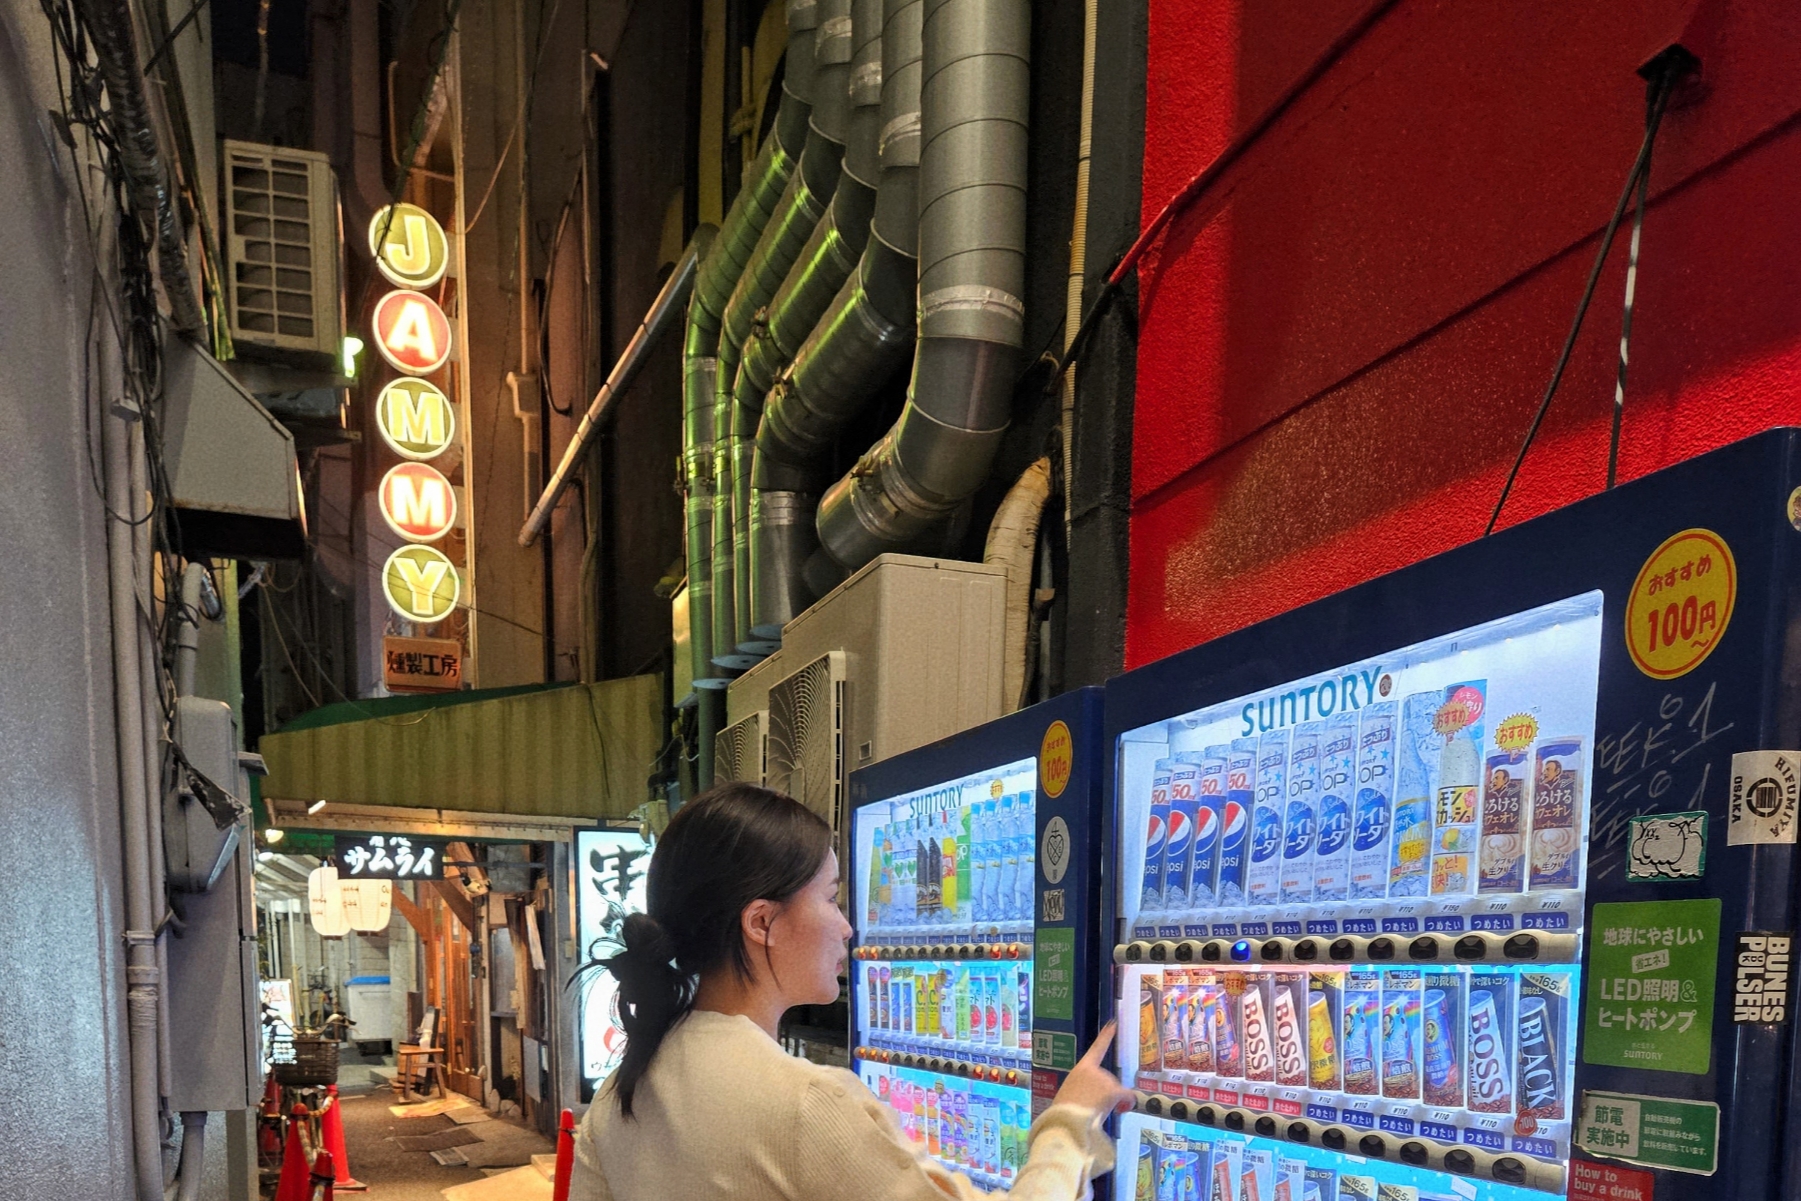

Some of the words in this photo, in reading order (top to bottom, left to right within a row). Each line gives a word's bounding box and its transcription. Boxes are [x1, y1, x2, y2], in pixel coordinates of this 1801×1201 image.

[384, 214, 446, 614] JAMMY
[1649, 554, 1711, 597] おすすめ
[1241, 665, 1382, 737] SUNTORY
[1436, 708, 1466, 728] おすすめ
[1500, 723, 1532, 743] おすすめ
[910, 784, 964, 819] SUNTORY
[1732, 775, 1743, 824] OSAKA
[344, 846, 435, 877] サムライ
[1489, 903, 1508, 911] ¥110
[1542, 901, 1561, 909] ¥110
[1274, 925, 1299, 934] つめたい
[1309, 923, 1335, 933] つめたい
[1345, 922, 1375, 932] つめたい
[1385, 922, 1415, 931] つめたい
[1427, 920, 1461, 931] つめたい
[1474, 919, 1511, 929] つめたい
[1525, 917, 1564, 928] つめたい
[1603, 926, 1704, 946] 地球にやさしい
[1635, 953, 1667, 970] 省エネ!
[1761, 936, 1791, 1022] BUNES
[1038, 985, 1069, 999] ヒートポンプ
[1598, 1006, 1698, 1034] ヒートポンプ
[1245, 999, 1268, 1070] BOSS
[1276, 1000, 1300, 1074] BOSS
[1470, 1007, 1504, 1099] BOSS
[1623, 1049, 1663, 1061] SUNTORY
[1519, 1017, 1556, 1109] BLACK
[1275, 1101, 1300, 1113] あたたかい
[1309, 1108, 1335, 1118] つめたい
[1393, 1107, 1408, 1115] ¥110
[1344, 1113, 1372, 1125] つめたい
[1434, 1112, 1450, 1120] ¥110
[1594, 1104, 1624, 1127] 節電
[1382, 1119, 1412, 1131] つめたい
[1480, 1119, 1497, 1127] ¥110
[1423, 1126, 1455, 1138] つめたい
[1467, 1132, 1501, 1145] つめたい
[1586, 1127, 1630, 1149] 実施中
[1515, 1140, 1553, 1153] つめたい
[1575, 1163, 1601, 1179] How
[1605, 1169, 1618, 1182] to
[1574, 1177, 1596, 1193] buy
[1599, 1184, 1607, 1194] a
[1610, 1184, 1644, 1201] drink
